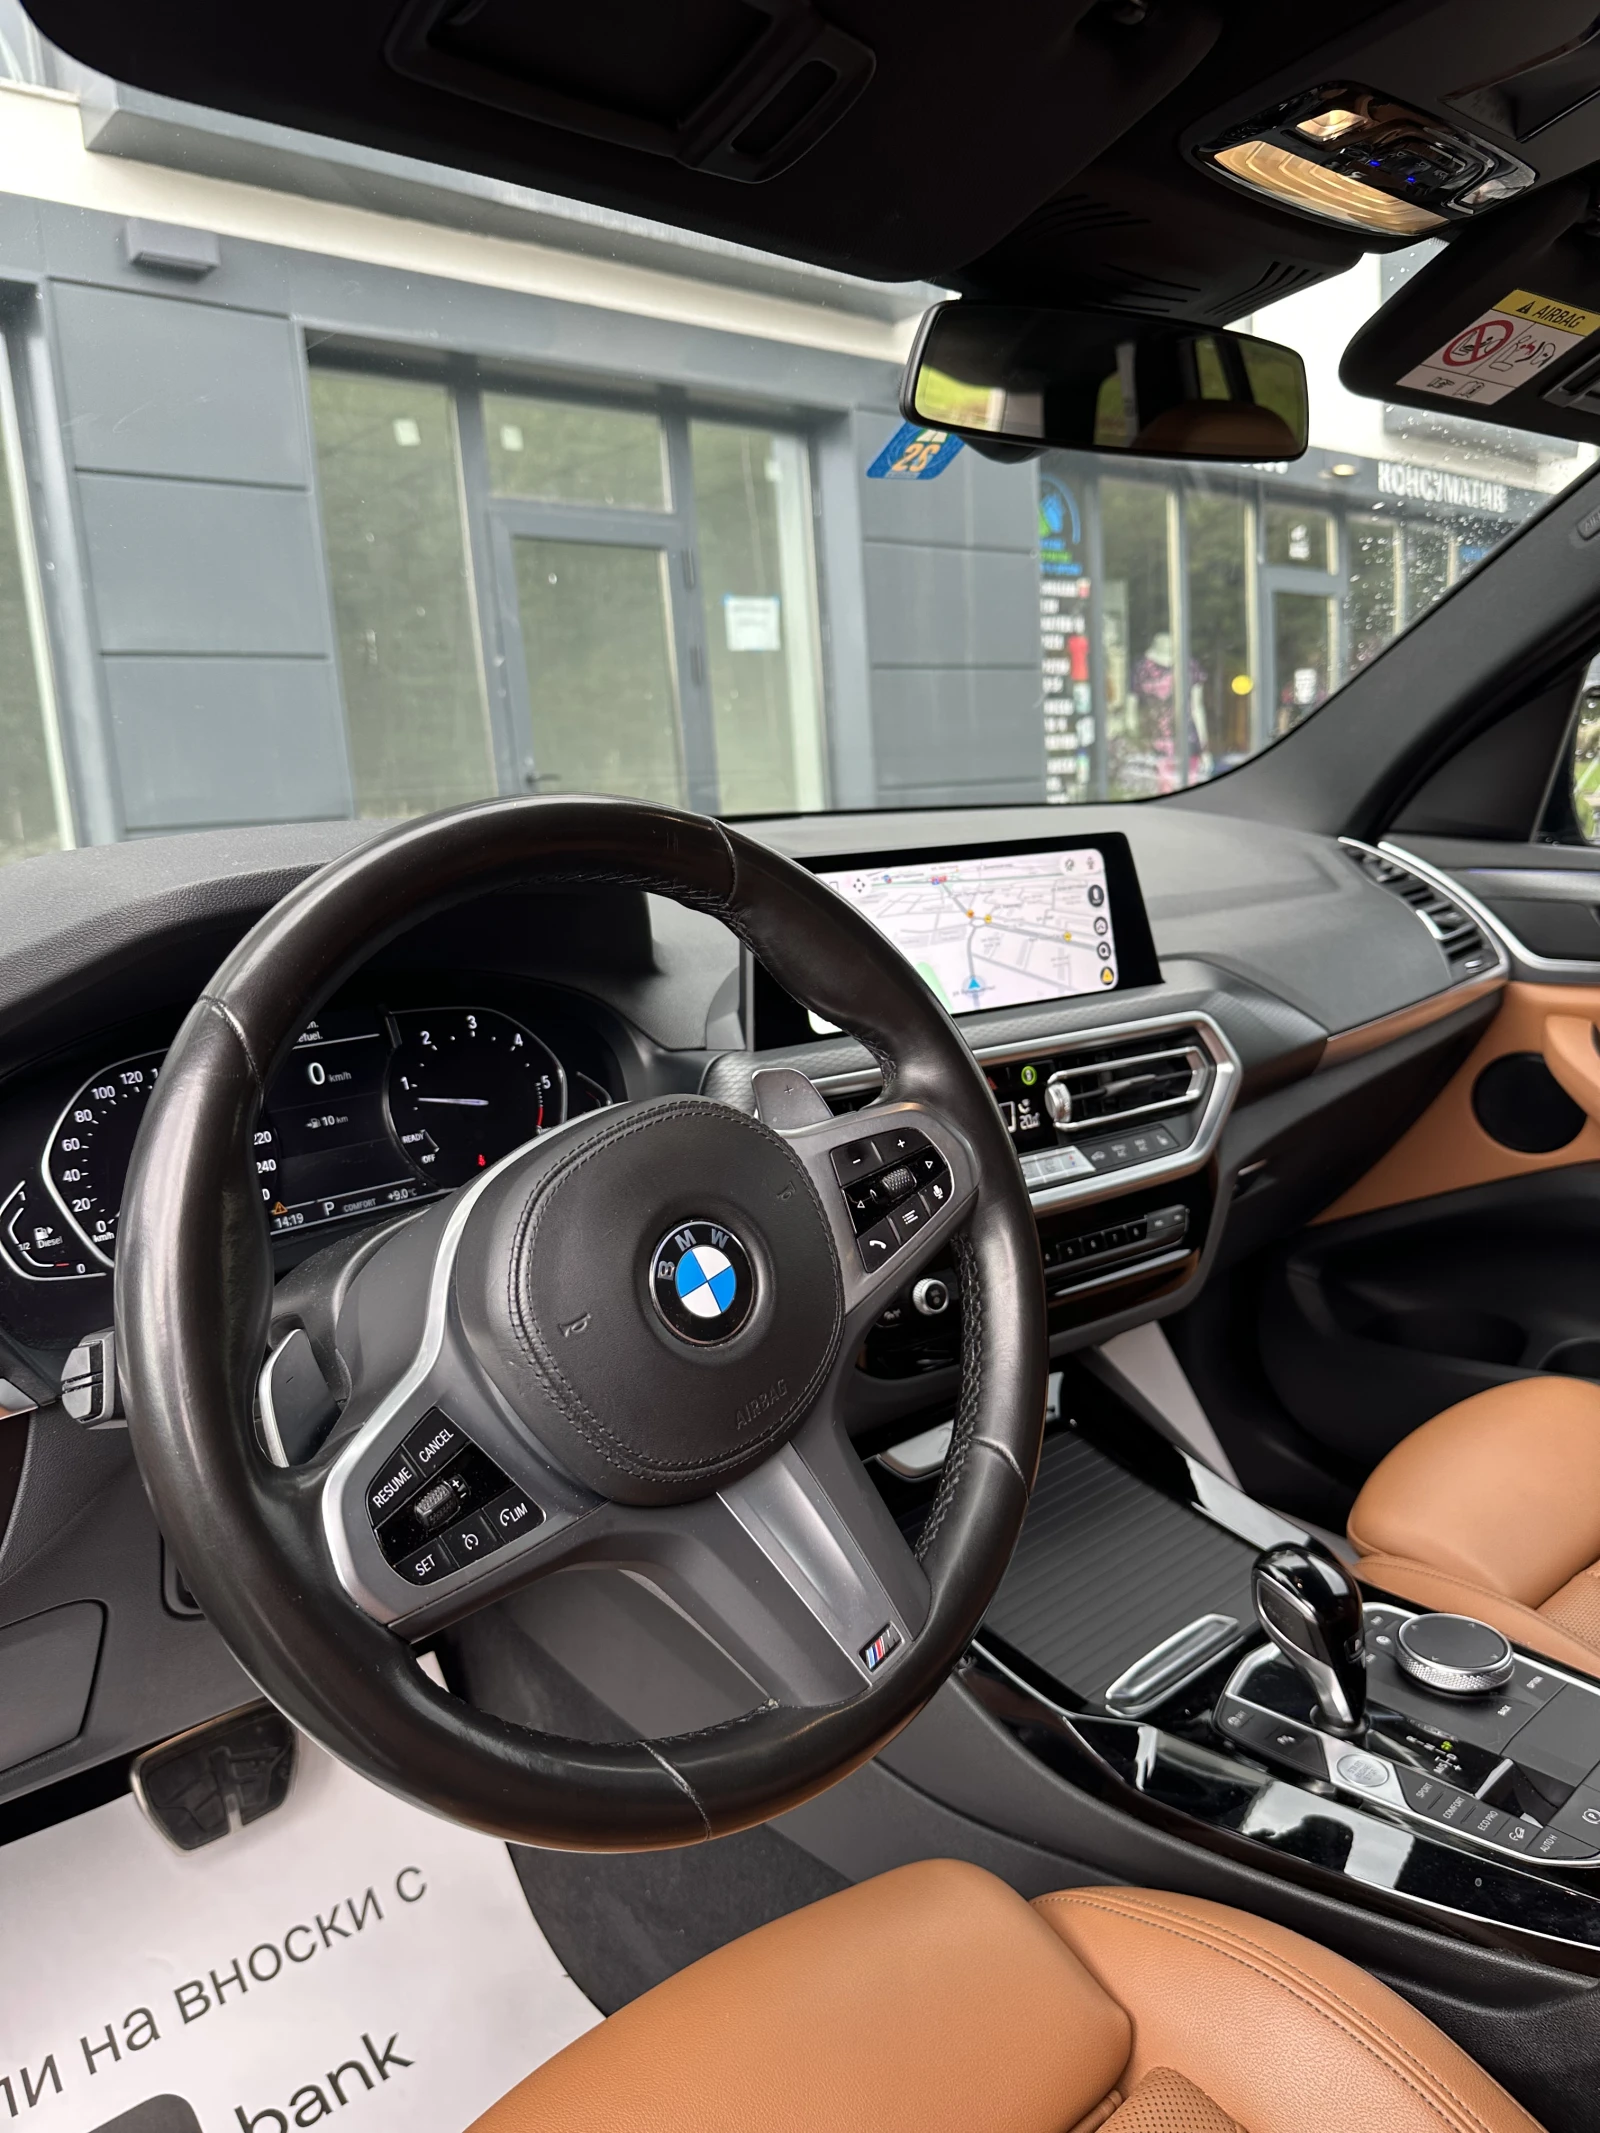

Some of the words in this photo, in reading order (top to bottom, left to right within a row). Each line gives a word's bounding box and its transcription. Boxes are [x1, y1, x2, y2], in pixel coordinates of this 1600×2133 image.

[1532, 305, 1585, 328] AIRBAG
[466, 1015, 477, 1029] 3
[297, 1031, 323, 1043] efuel.
[420, 1031, 431, 1045] 2
[514, 1033, 523, 1047] 4
[120, 1070, 143, 1084] 120
[308, 1062, 325, 1085] 0
[328, 1071, 352, 1083] km/h
[401, 1076, 410, 1090] 1
[541, 1075, 551, 1089] 5
[91, 1085, 116, 1099] 100
[74, 1109, 93, 1123] 80
[322, 1115, 335, 1126] 10
[336, 1116, 349, 1124] km
[61, 1137, 81, 1152] 60
[402, 1132, 425, 1144] READY
[421, 1153, 436, 1164] OFF
[62, 1168, 81, 1182] 40
[71, 1197, 91, 1213] 20
[274, 1212, 304, 1229] 14:19
[323, 1201, 335, 1216] P
[342, 1198, 377, 1213] COMFORT
[95, 1220, 107, 1233] 0
[36, 1235, 63, 1249] Diesel
[92, 1231, 115, 1243] km/h
[18, 1242, 31, 1251] 1/2
[657, 1228, 729, 1281] BMW
[76, 1263, 86, 1274] 0
[735, 1378, 788, 1430] AIRBAG
[418, 1429, 454, 1463] CANCEL
[372, 1466, 412, 1508] RESUME
[511, 1502, 528, 1522] LIM
[415, 1554, 436, 1576] SET
[1415, 1782, 1433, 1798] SPORT
[1442, 1796, 1465, 1819] COMFORT
[1477, 1818, 1490, 1831] ECO
[1485, 1810, 1499, 1822] PRO
[1540, 1837, 1554, 1853] AUTO
[79, 2006, 162, 2076] на
[173, 1886, 386, 2024] вноски
[234, 2031, 416, 2133] bank
